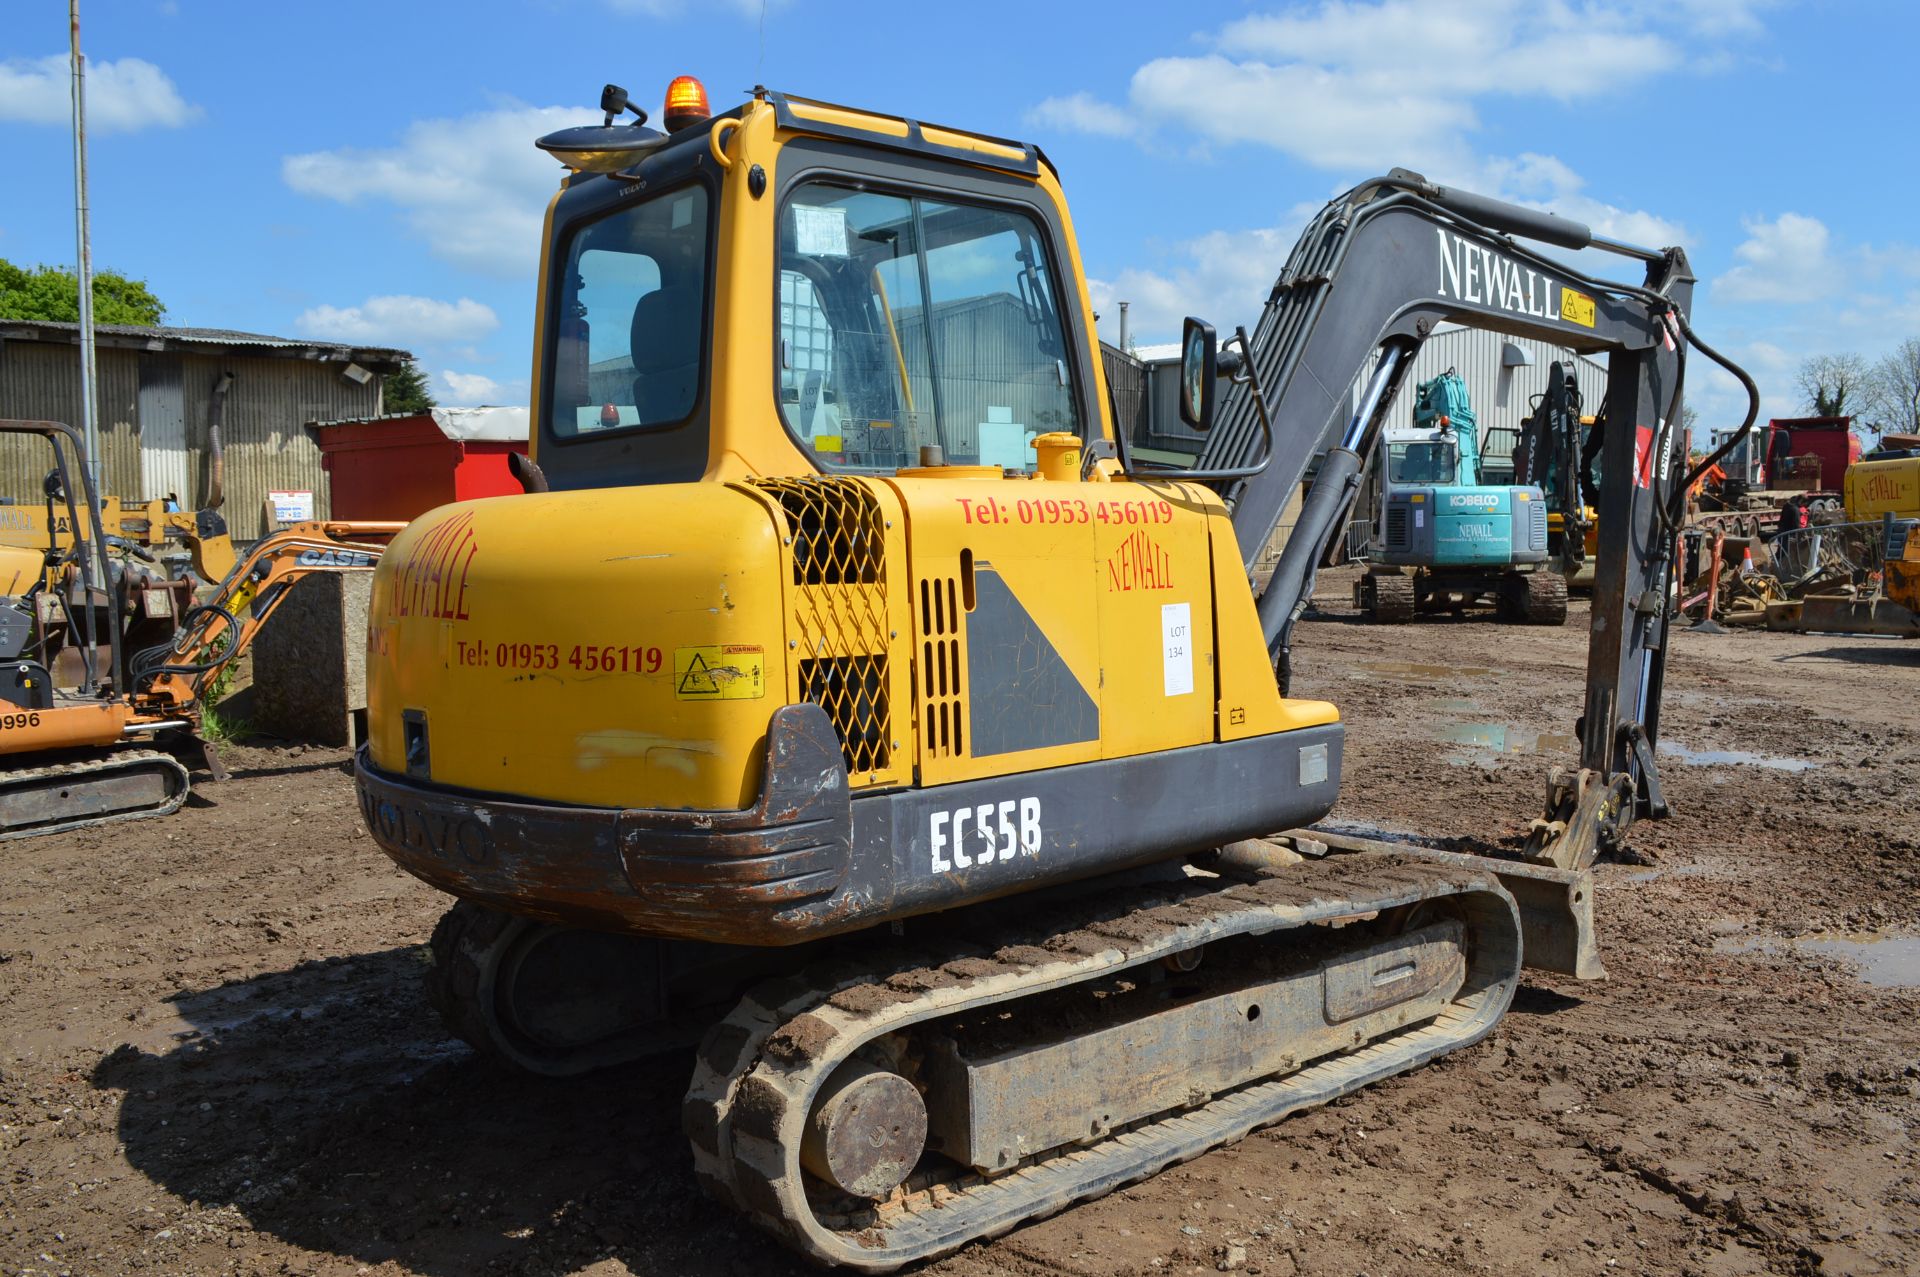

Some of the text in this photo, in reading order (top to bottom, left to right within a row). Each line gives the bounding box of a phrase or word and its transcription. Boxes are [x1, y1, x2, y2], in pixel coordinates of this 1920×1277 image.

[619, 180, 647, 197] VOLVO
[1437, 228, 1560, 321] NEWALL
[1526, 434, 1537, 484] OLVO
[1450, 494, 1499, 507] KOBELCO
[1861, 475, 1902, 501] NEWALL
[956, 497, 1173, 525] Tel: 01953 456119
[1459, 524, 1492, 538] NEWALL
[300, 549, 370, 566] CASE
[1108, 527, 1174, 592] NEWALL
[1170, 626, 1186, 638] LOT
[457, 640, 662, 673] Tel: 01953 456119
[1169, 646, 1183, 658] 134
[930, 796, 1042, 874] EC55B
